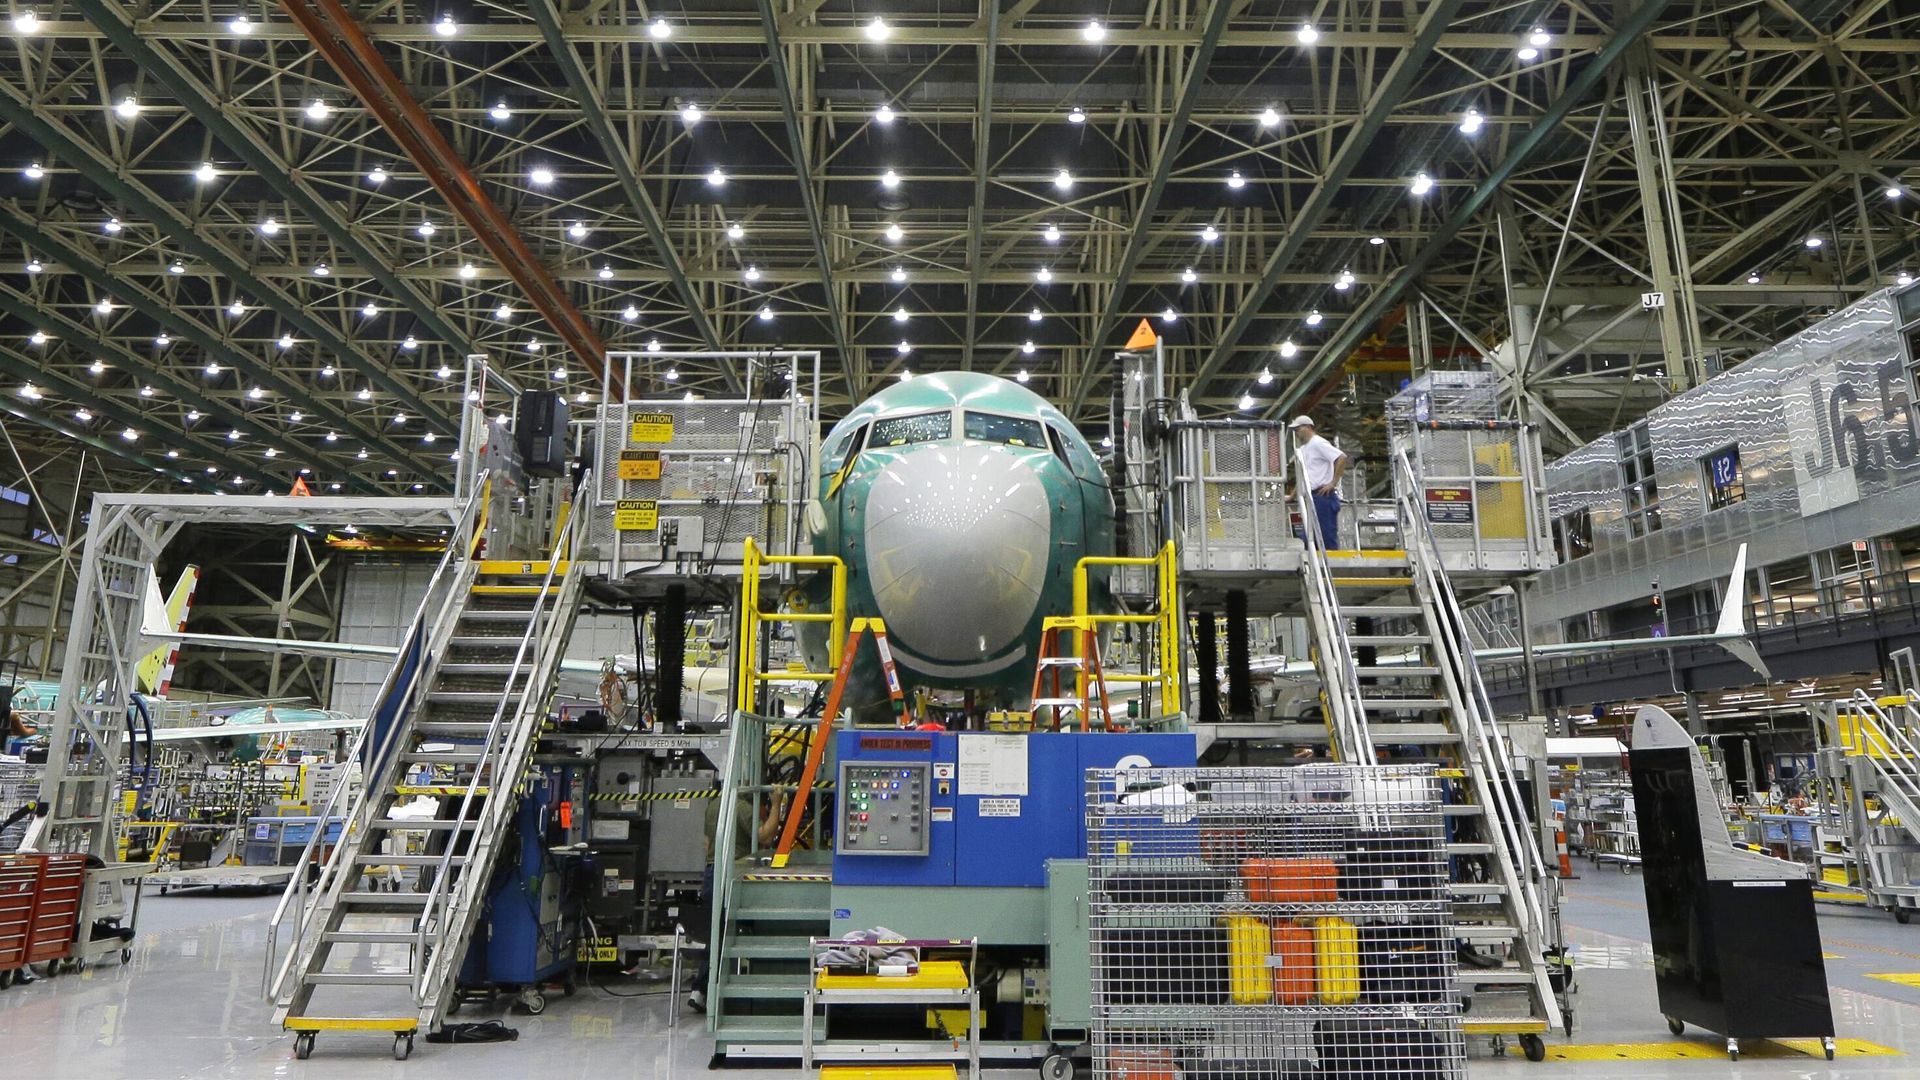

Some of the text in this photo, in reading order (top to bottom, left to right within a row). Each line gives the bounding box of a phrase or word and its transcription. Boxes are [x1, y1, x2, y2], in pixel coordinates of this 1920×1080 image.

[1644, 294, 1661, 306] J7
[635, 415, 672, 424] CAUTION
[1717, 456, 1732, 484] 12
[599, 950, 615, 959] ONLY
